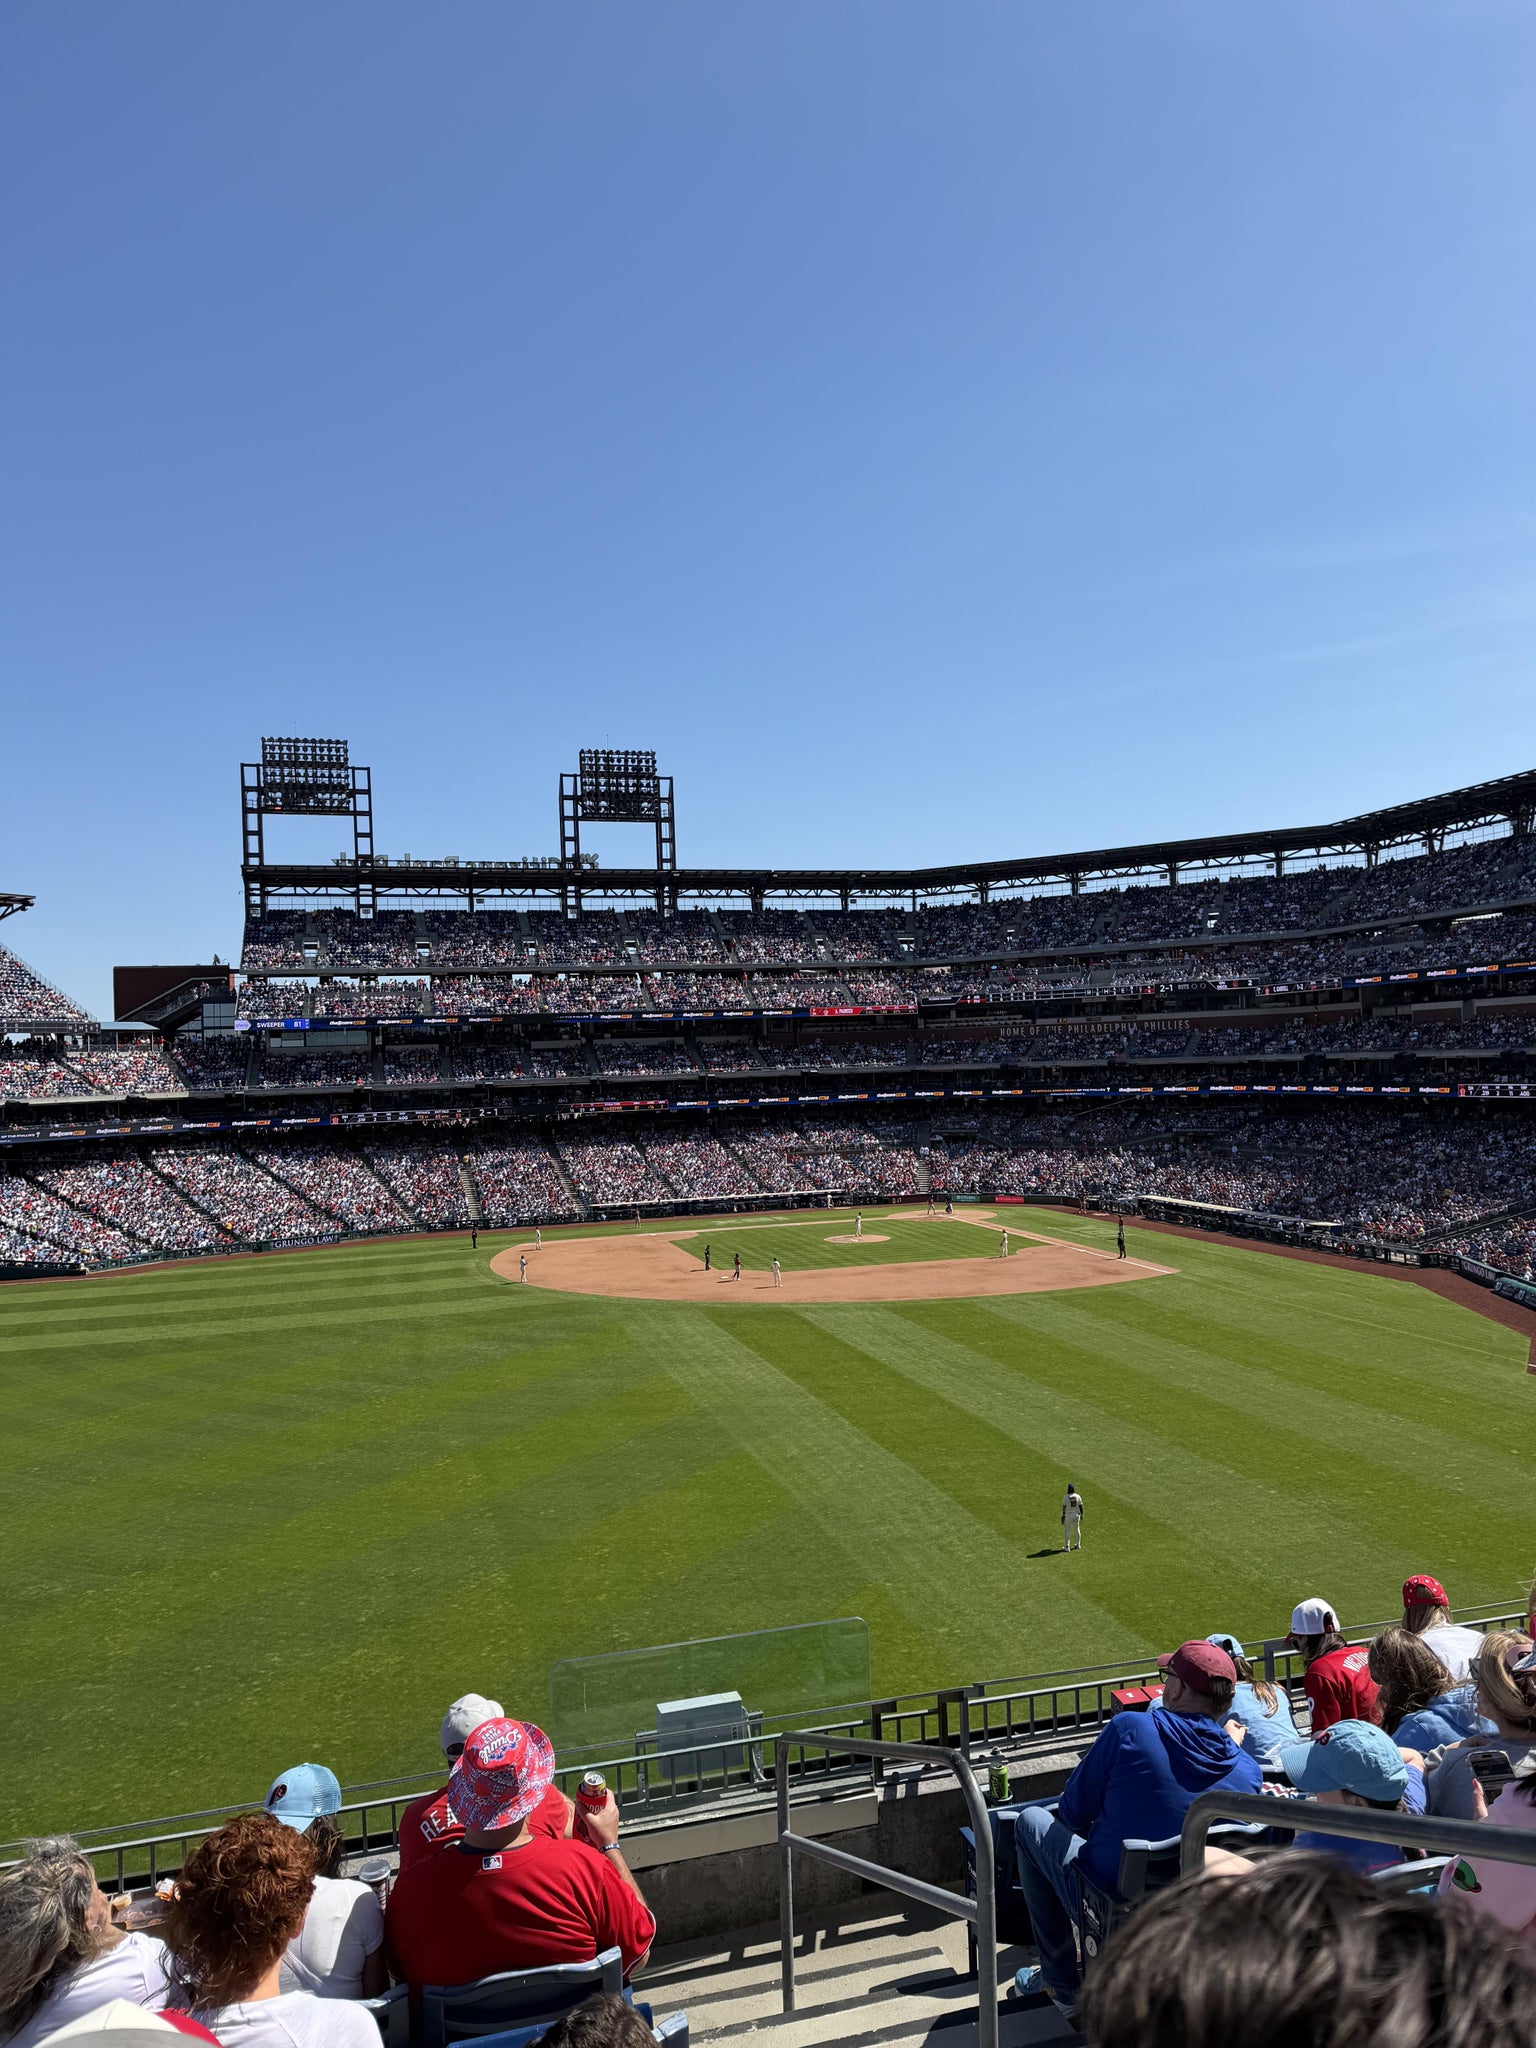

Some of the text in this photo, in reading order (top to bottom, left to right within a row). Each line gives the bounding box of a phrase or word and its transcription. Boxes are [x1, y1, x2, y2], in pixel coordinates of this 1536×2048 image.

[1000, 1020, 1190, 1037] HOME OF THE PHILADELPHIA PHILLIES
[275, 1237, 314, 1248] GRUNGO
[1464, 1260, 1484, 1277] GRUNGO
[479, 1728, 522, 1764] Drunk
[268, 1783, 288, 1806] P
[420, 1803, 458, 1842] REA
